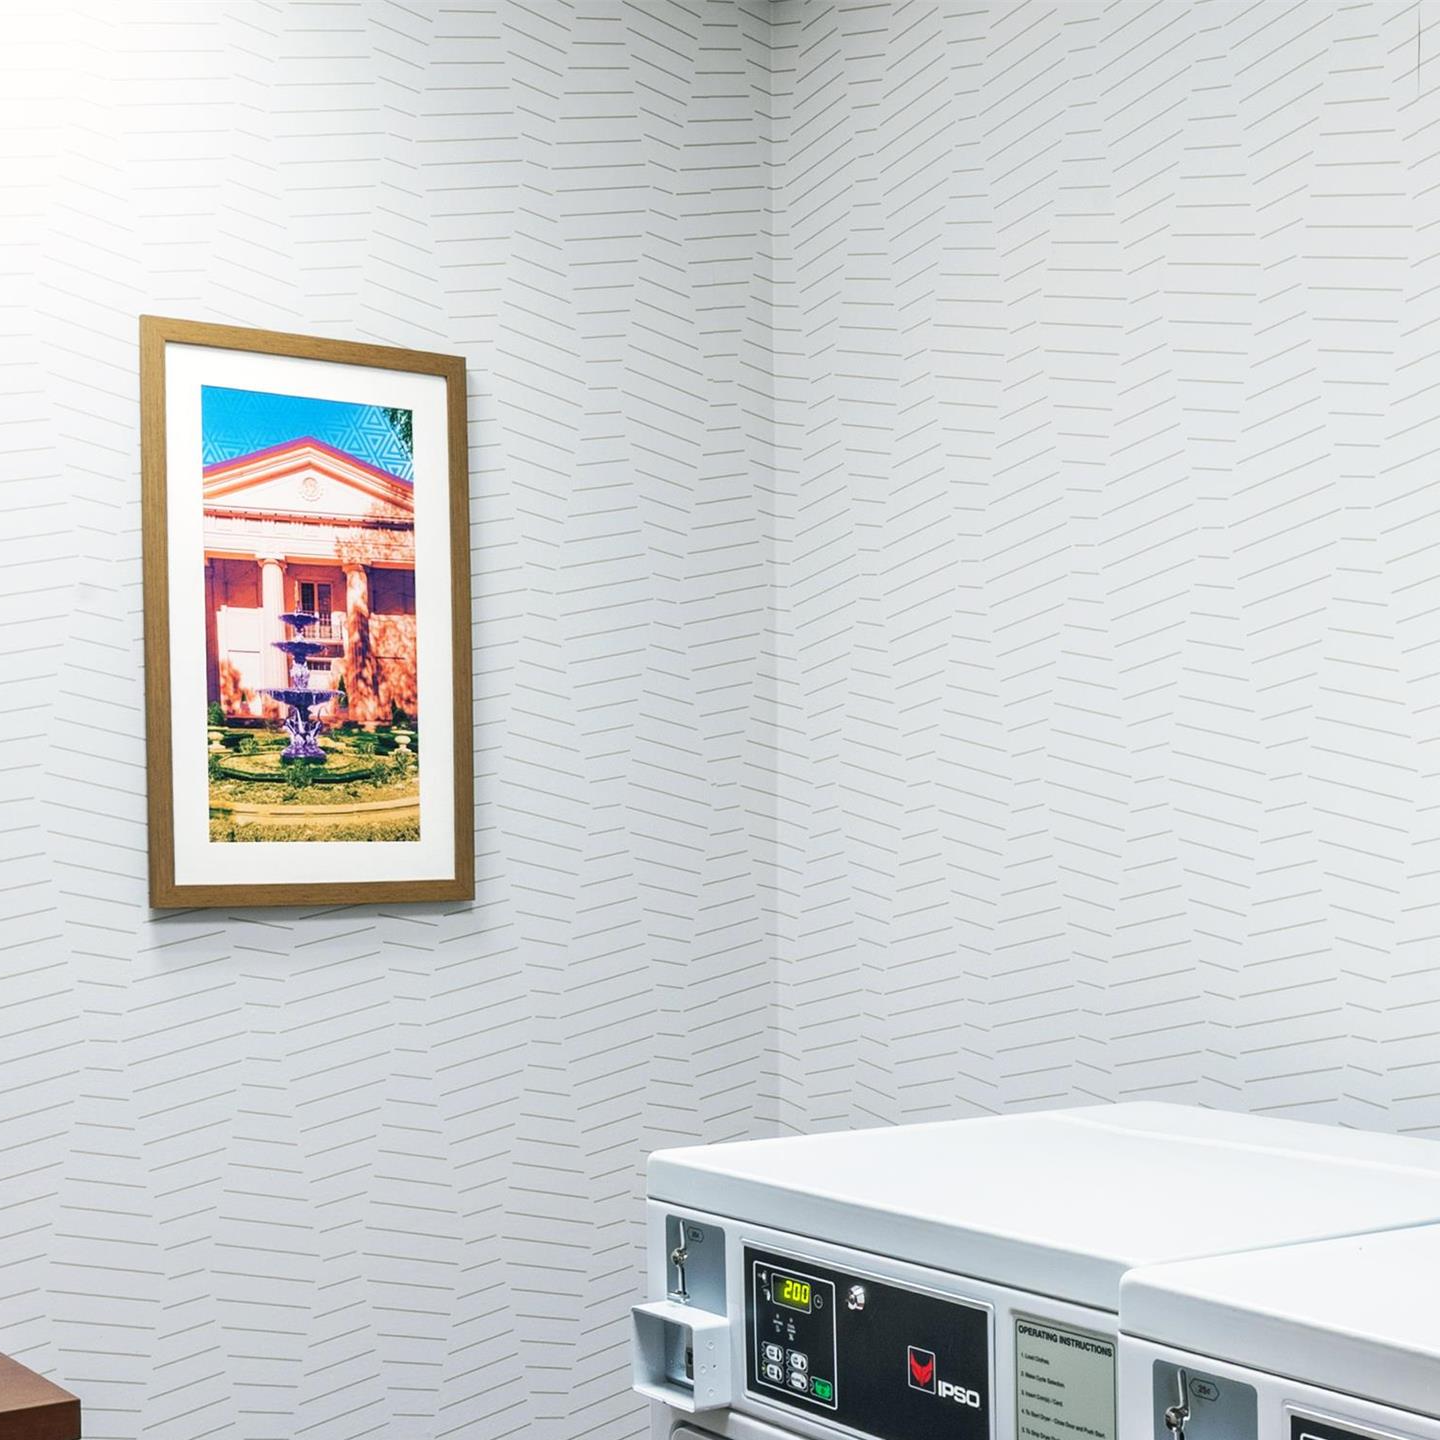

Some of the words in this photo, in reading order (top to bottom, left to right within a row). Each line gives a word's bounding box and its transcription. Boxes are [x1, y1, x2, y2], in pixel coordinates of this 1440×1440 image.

[784, 1280, 809, 1304] 200
[1019, 1325, 1058, 1343] OPERATING
[1059, 1336, 1112, 1358] INSTRUCTIONS
[938, 1380, 980, 1408] IPSO
